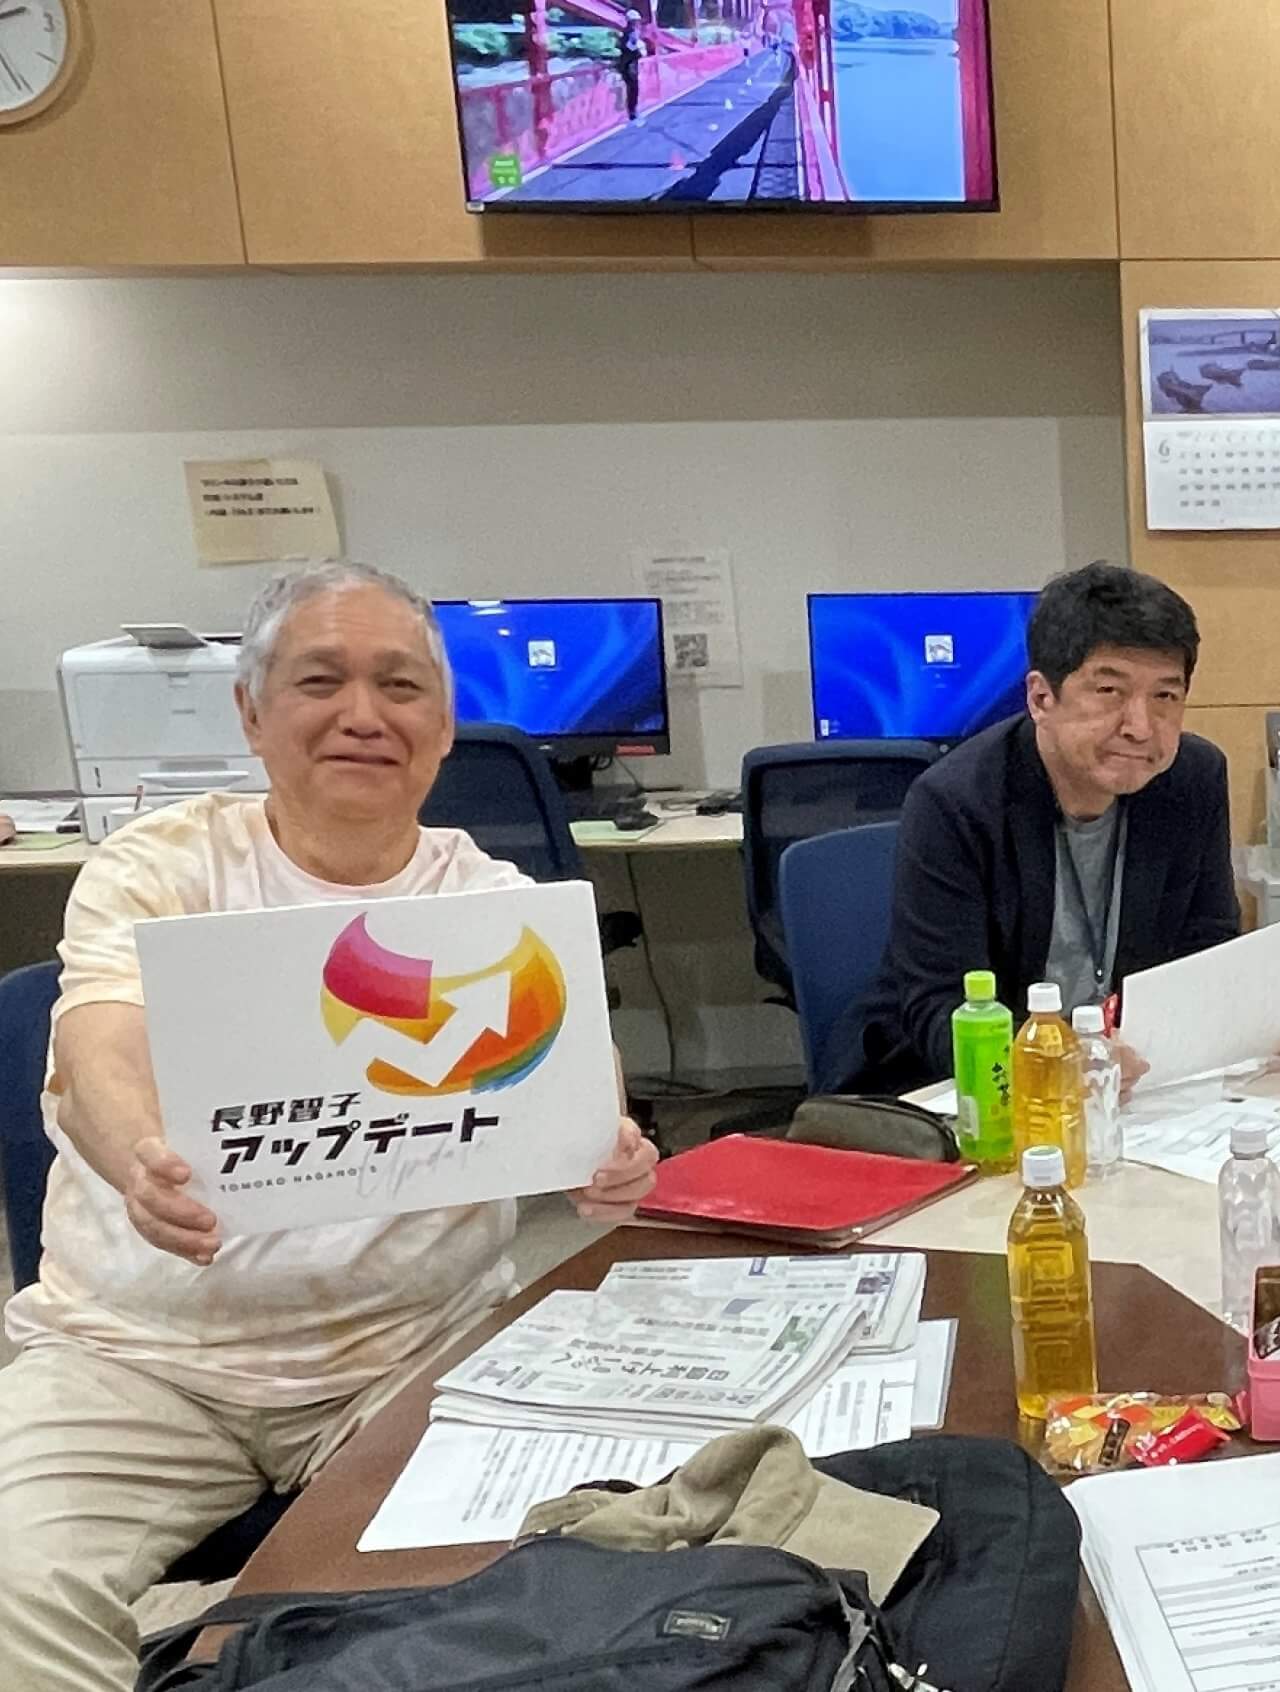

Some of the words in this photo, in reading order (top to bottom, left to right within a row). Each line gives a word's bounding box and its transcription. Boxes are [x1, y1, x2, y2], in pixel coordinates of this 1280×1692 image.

[43, 11, 56, 32] 3
[1158, 439, 1170, 457] 6
[211, 1092, 361, 1133] 長野智子
[220, 1107, 499, 1174] アップデート
